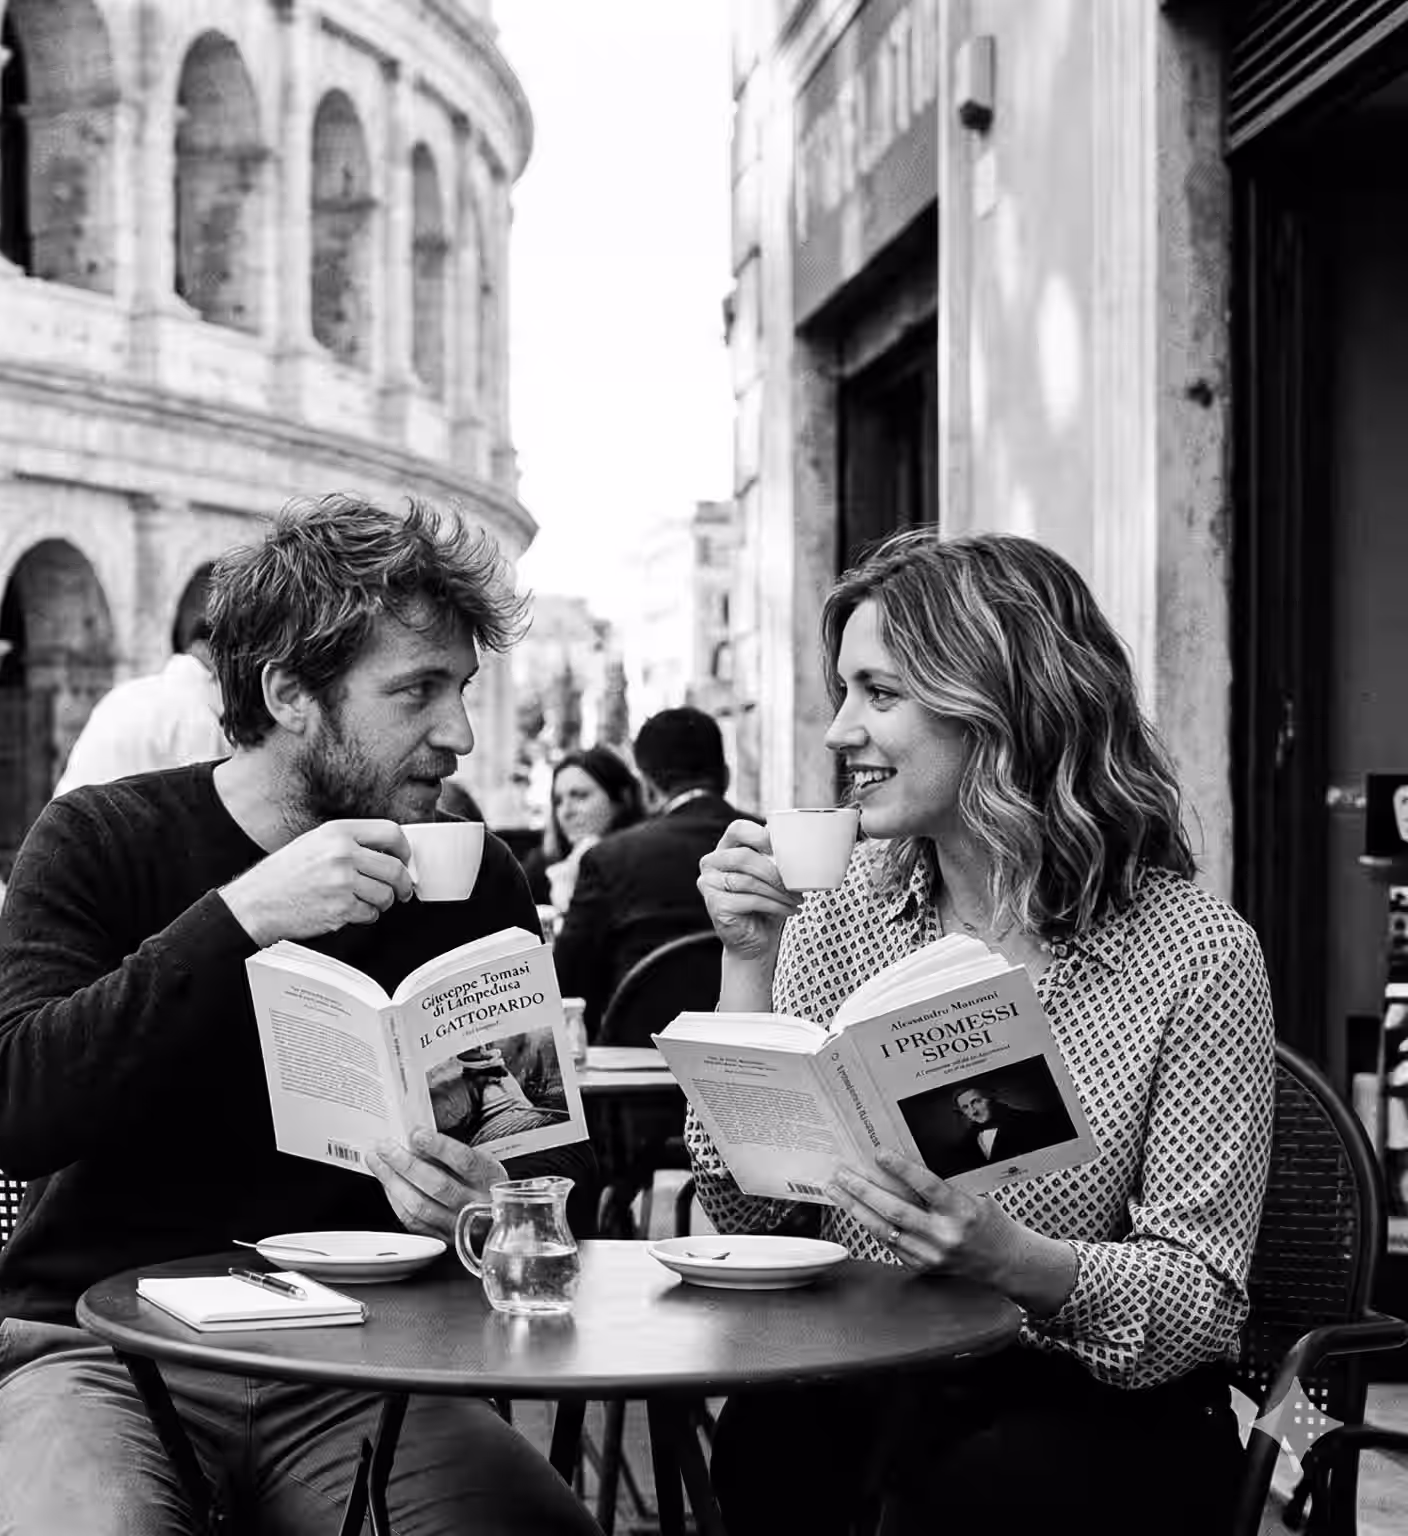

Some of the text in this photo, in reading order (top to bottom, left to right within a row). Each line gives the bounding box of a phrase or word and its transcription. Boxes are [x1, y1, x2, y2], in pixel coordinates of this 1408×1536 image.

[481, 961, 530, 984] Tomasi
[433, 980, 521, 1017] di Lampedusa
[420, 1033, 432, 1048] IL
[435, 993, 545, 1037] GATTOPARDO
[880, 1002, 1020, 1058] I PROMESSI
[921, 1030, 992, 1062] SPOSI
